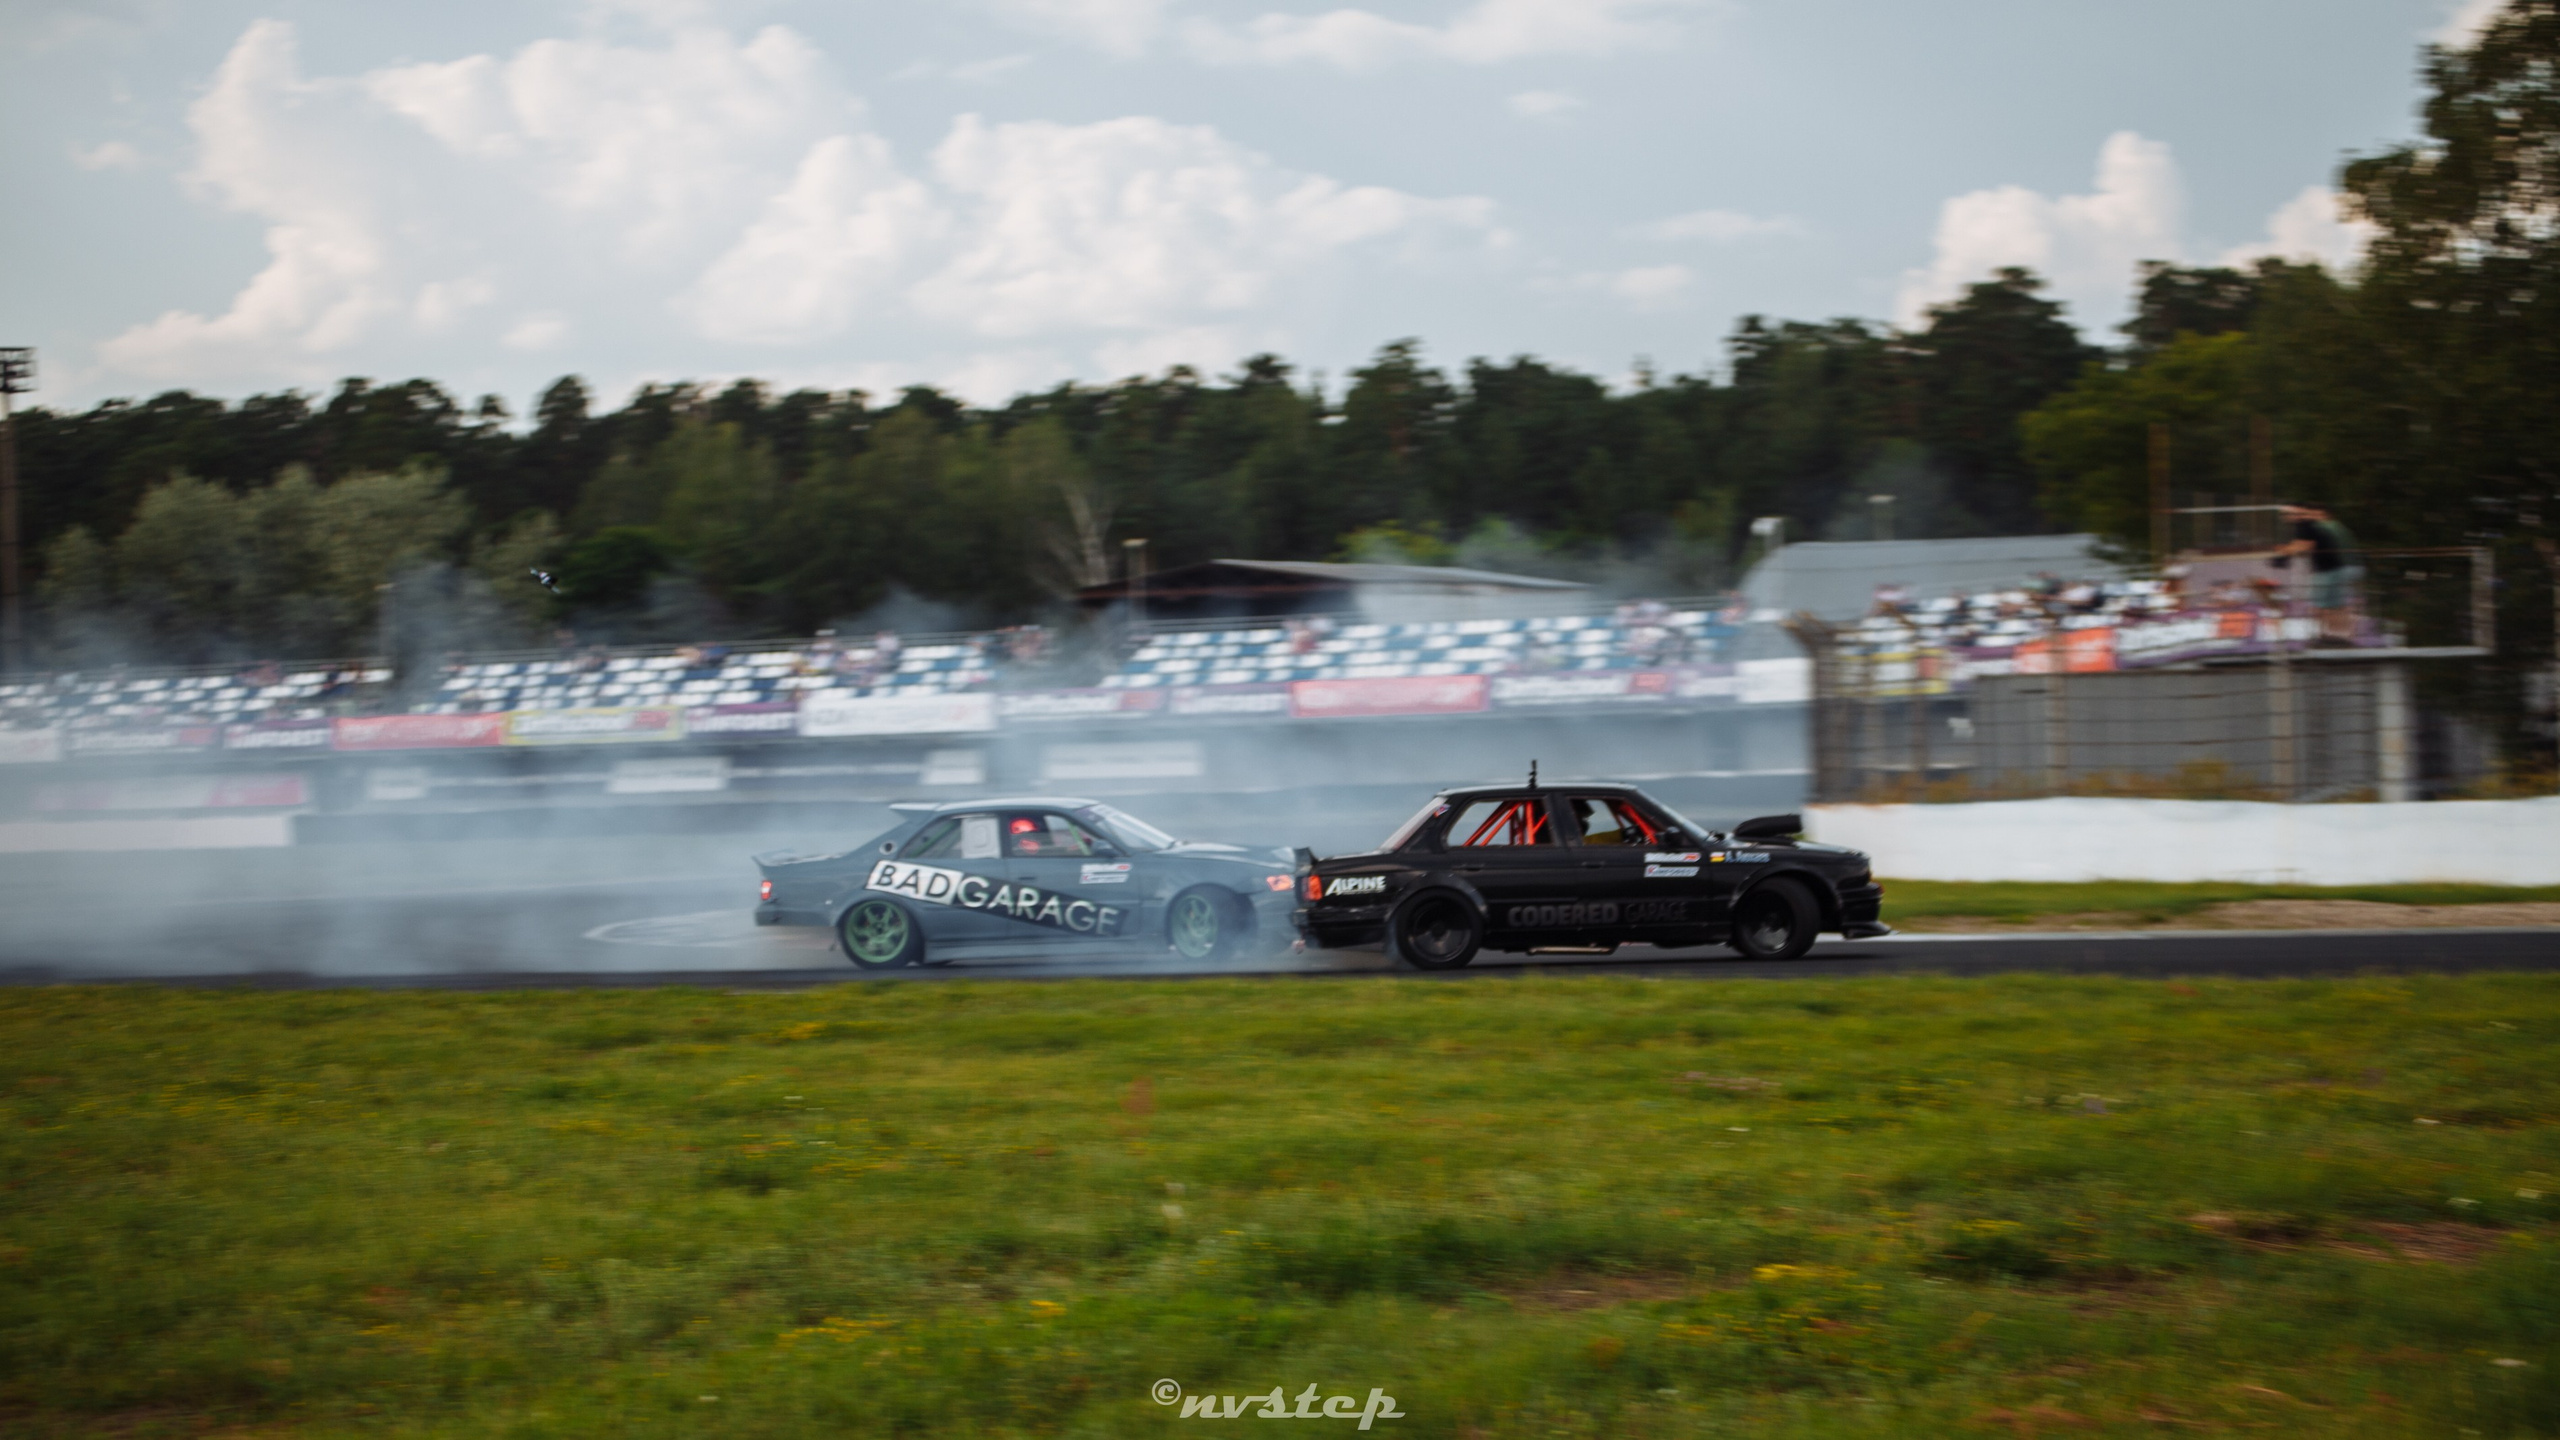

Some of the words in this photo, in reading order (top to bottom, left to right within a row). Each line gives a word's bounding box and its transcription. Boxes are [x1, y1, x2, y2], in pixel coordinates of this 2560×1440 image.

[1324, 875, 1387, 896] ALPINE
[1507, 902, 1620, 927] CODERED
[1624, 901, 1690, 923] GARAGE
